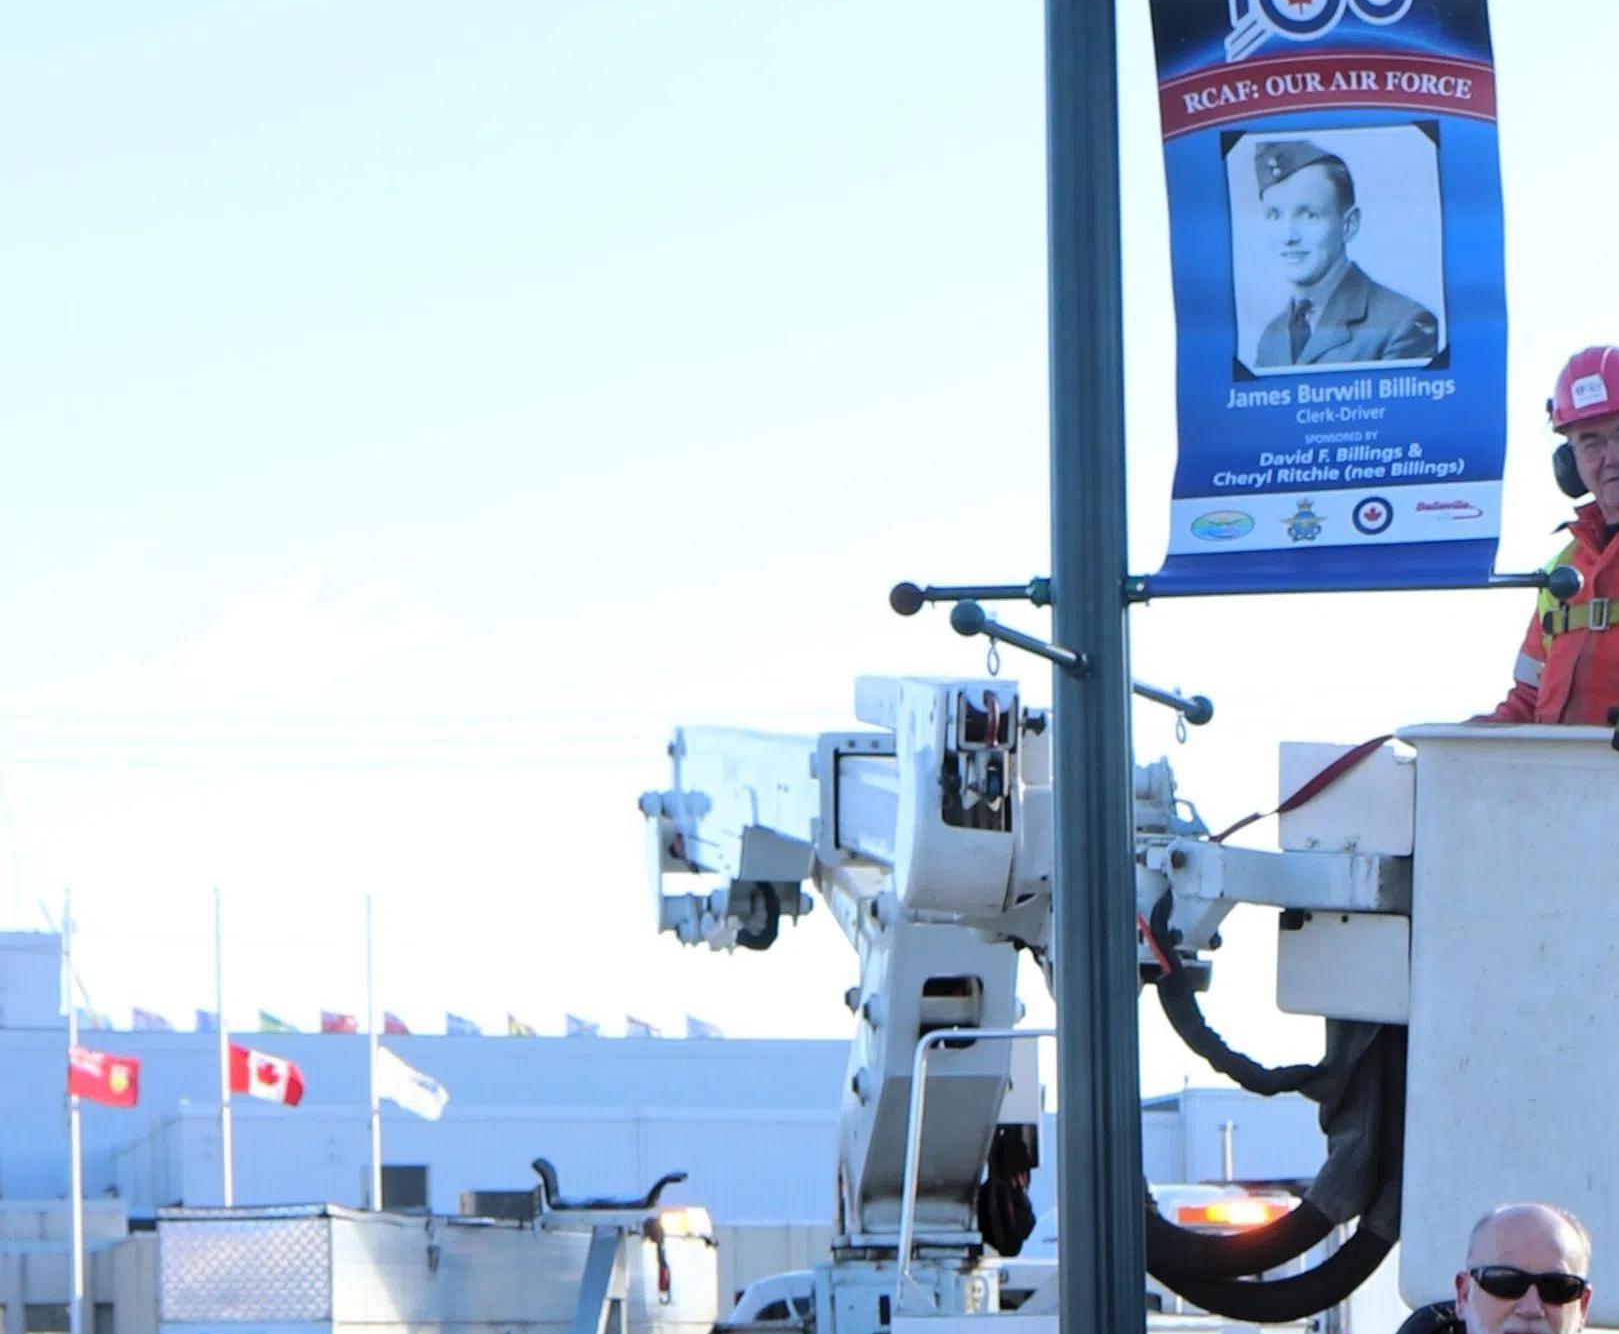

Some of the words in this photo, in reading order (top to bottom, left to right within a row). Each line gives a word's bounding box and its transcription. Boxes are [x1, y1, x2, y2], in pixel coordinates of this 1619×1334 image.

[1183, 80, 1259, 114] RCAF:
[1265, 72, 1325, 97] OUR
[1329, 70, 1379, 91] AIR
[1384, 71, 1472, 99] FORCE
[1227, 388, 1292, 409] James
[1297, 378, 1372, 404] Burwill
[1379, 376, 1455, 400] Billings
[1296, 405, 1386, 424] Clerk-Driver
[1364, 430, 1379, 442] BY
[1259, 448, 1314, 467] David
[1318, 448, 1330, 464] F.
[1336, 445, 1403, 463] Billings
[1408, 442, 1423, 458] &
[1212, 469, 1273, 488] Cheryl
[1276, 466, 1340, 483] Ritchie
[1344, 463, 1386, 482] (nee
[1390, 457, 1465, 478] Billings)
